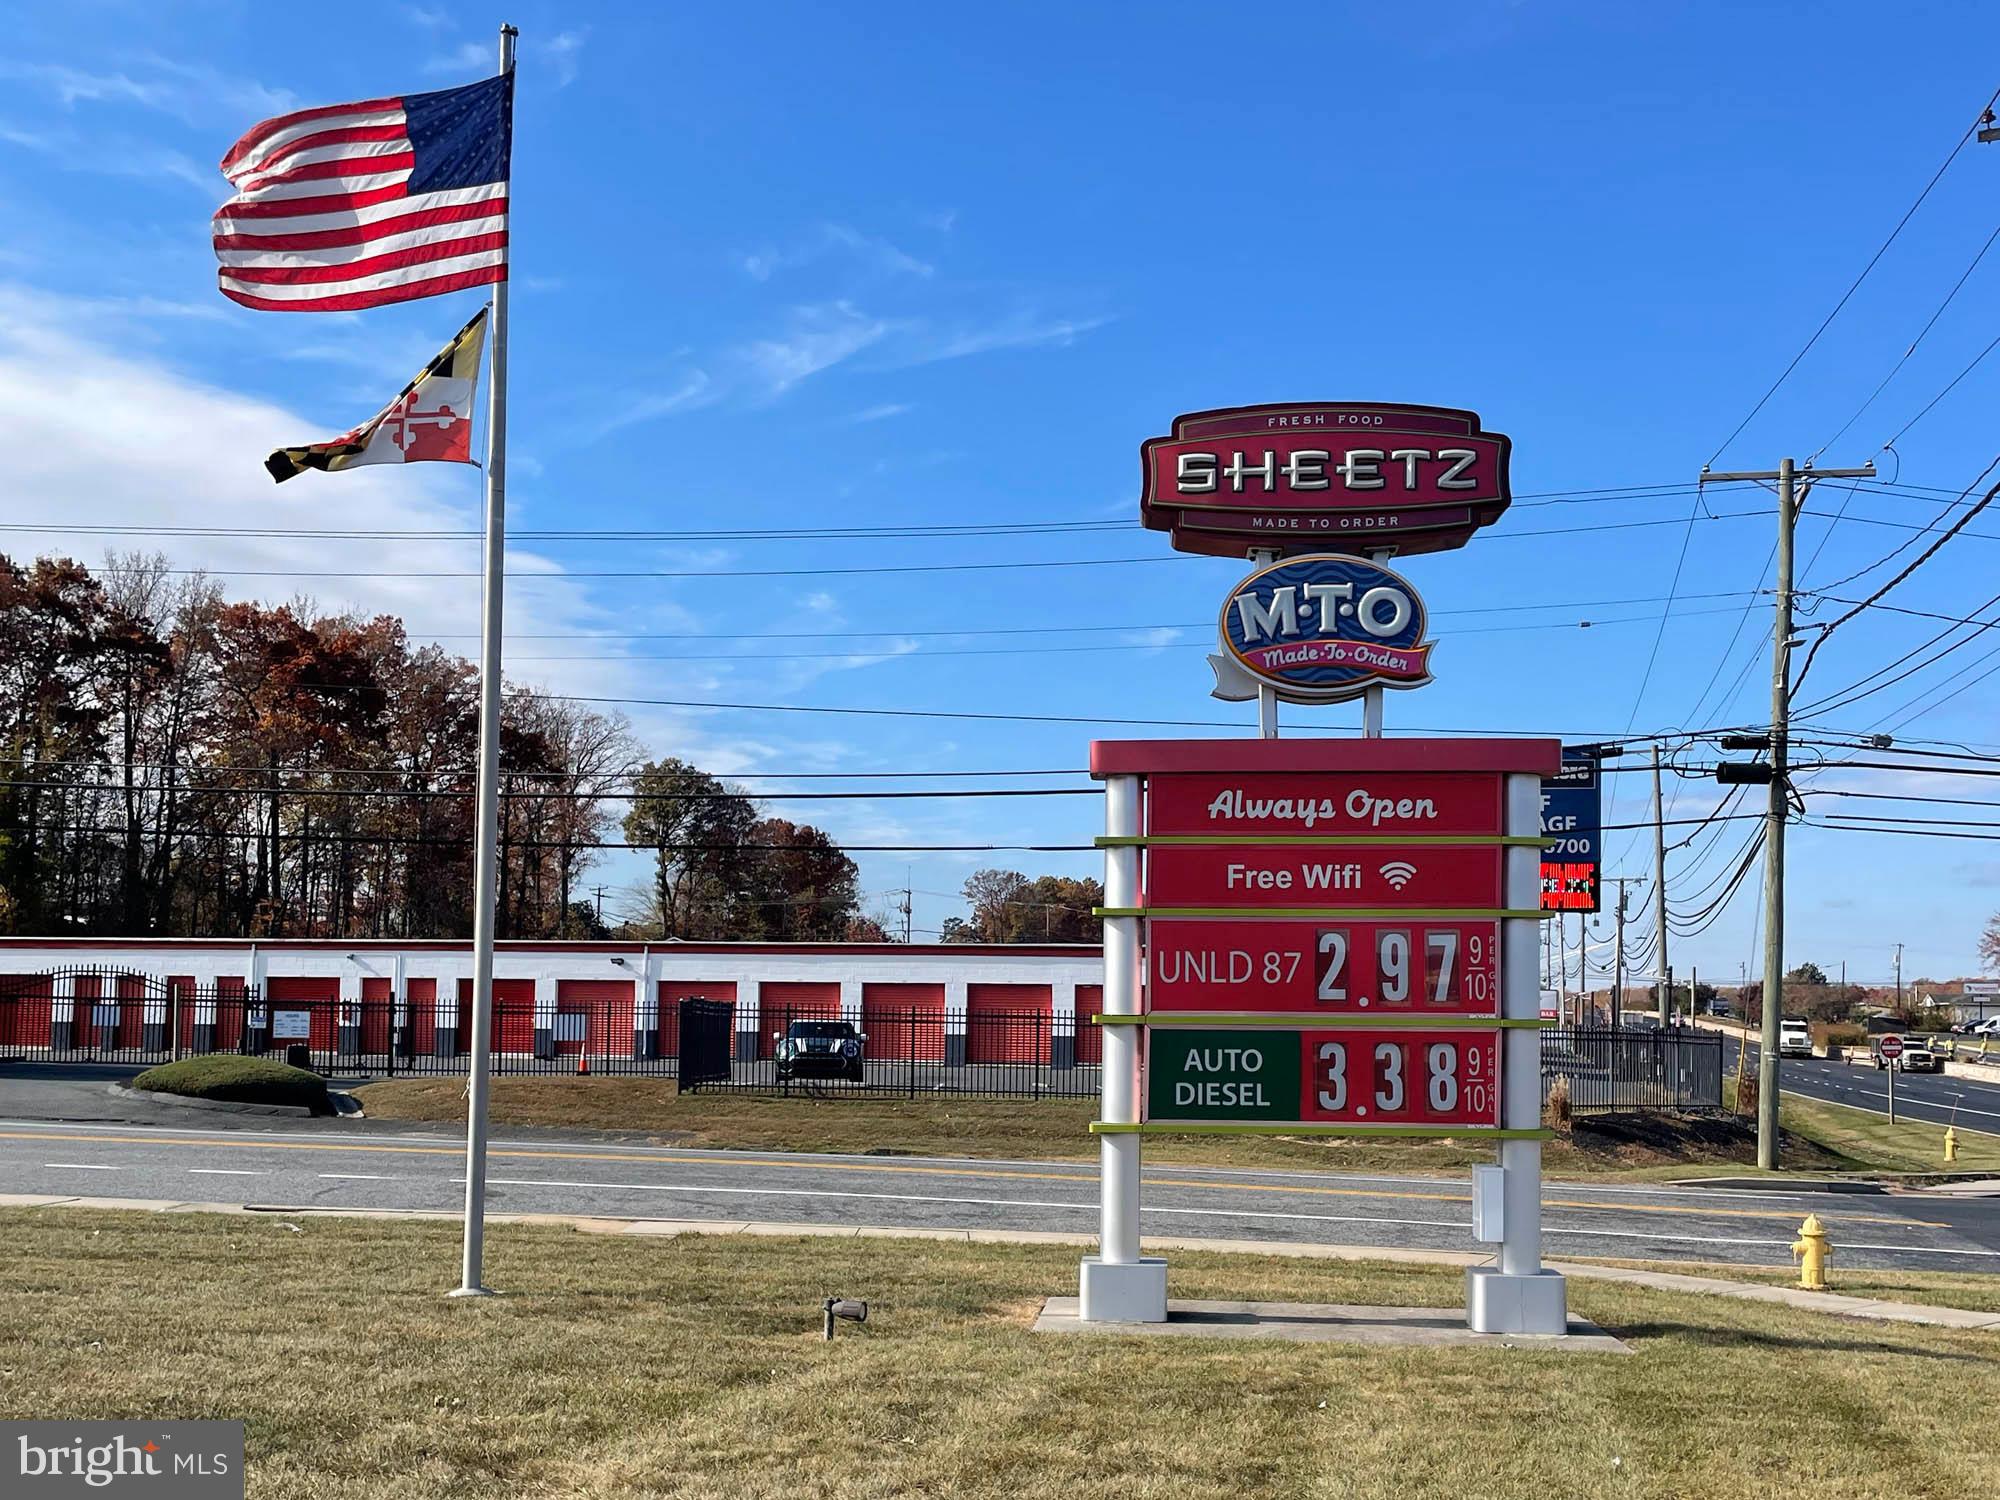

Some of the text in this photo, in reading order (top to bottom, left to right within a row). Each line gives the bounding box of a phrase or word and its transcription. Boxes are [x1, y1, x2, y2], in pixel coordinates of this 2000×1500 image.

[1268, 415, 1383, 427] FRESH FOOD
[1177, 449, 1477, 492] SHEETZ
[1252, 517, 1399, 528] MADE TO ORDER
[1207, 789, 1438, 828] Always Open
[1227, 864, 1361, 889] Free Wifi
[1470, 936, 1481, 964] 9
[1158, 950, 1253, 984] UNLD
[1263, 951, 1302, 984] 87
[1488, 936, 1496, 1001] PER GAL
[1465, 973, 1486, 1001] 10
[1183, 1049, 1264, 1073] AUTO
[1468, 1047, 1480, 1076] 9
[1175, 1082, 1271, 1107] DIESEL
[1464, 1085, 1486, 1113] 10
